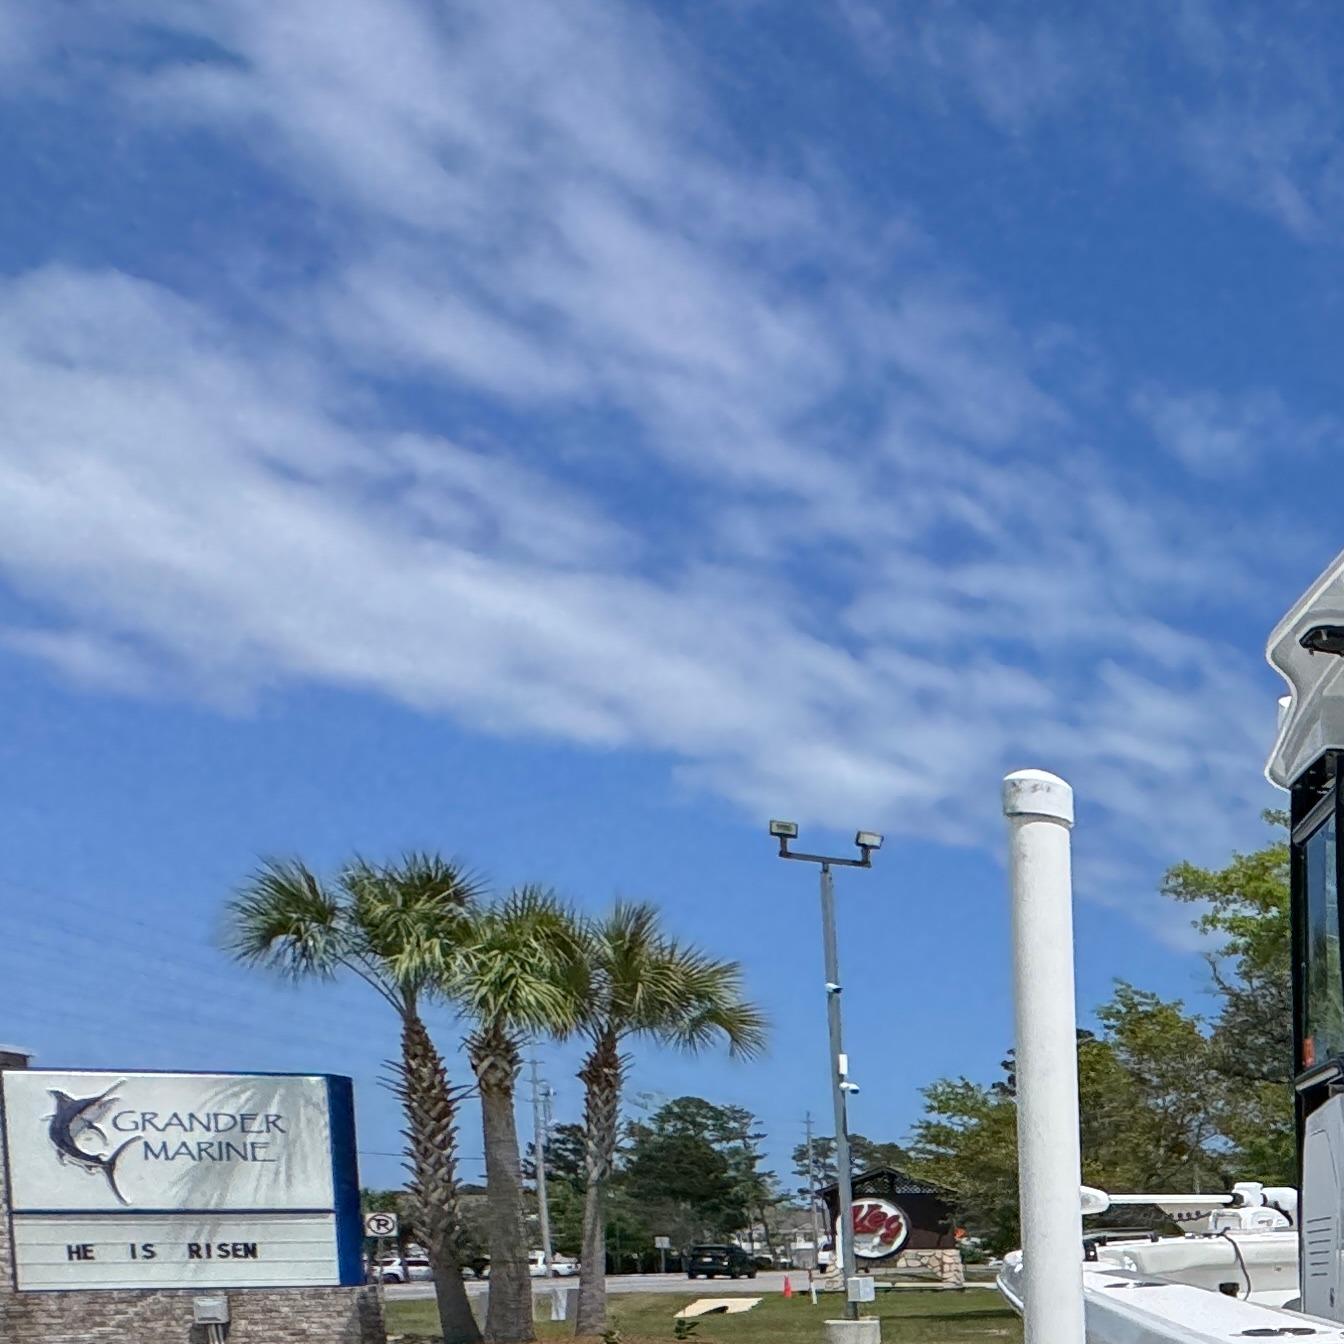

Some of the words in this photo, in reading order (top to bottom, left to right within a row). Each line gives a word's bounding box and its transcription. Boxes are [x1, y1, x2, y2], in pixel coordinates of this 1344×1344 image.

[112, 1110, 287, 1134] GRANDER
[143, 1141, 278, 1162] MARINE
[67, 1244, 95, 1261] HE
[130, 1243, 157, 1260] IS
[187, 1243, 258, 1260] RISEN
